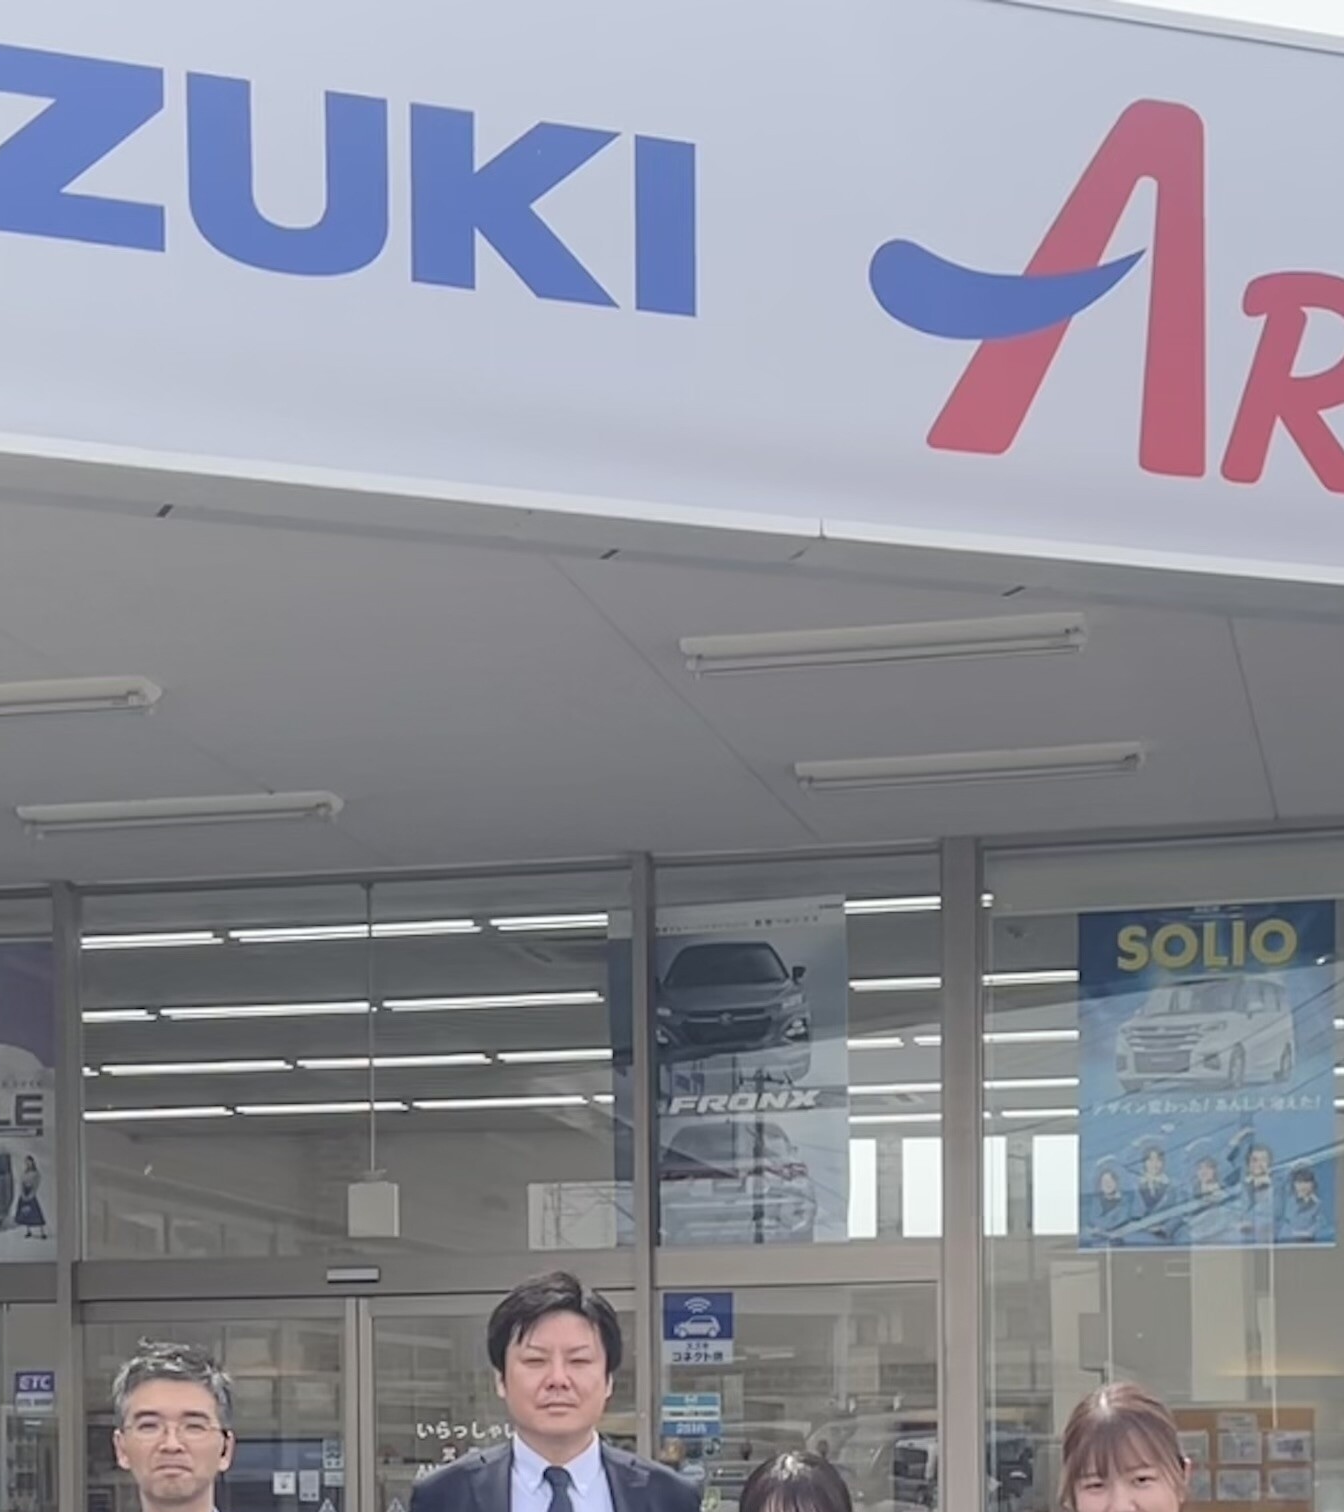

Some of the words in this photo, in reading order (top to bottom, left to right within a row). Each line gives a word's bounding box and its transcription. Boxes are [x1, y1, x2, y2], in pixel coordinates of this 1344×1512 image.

[1117, 918, 1298, 972] SOLIO
[668, 1089, 822, 1116] FRONX
[19, 1375, 52, 1391] ETC
